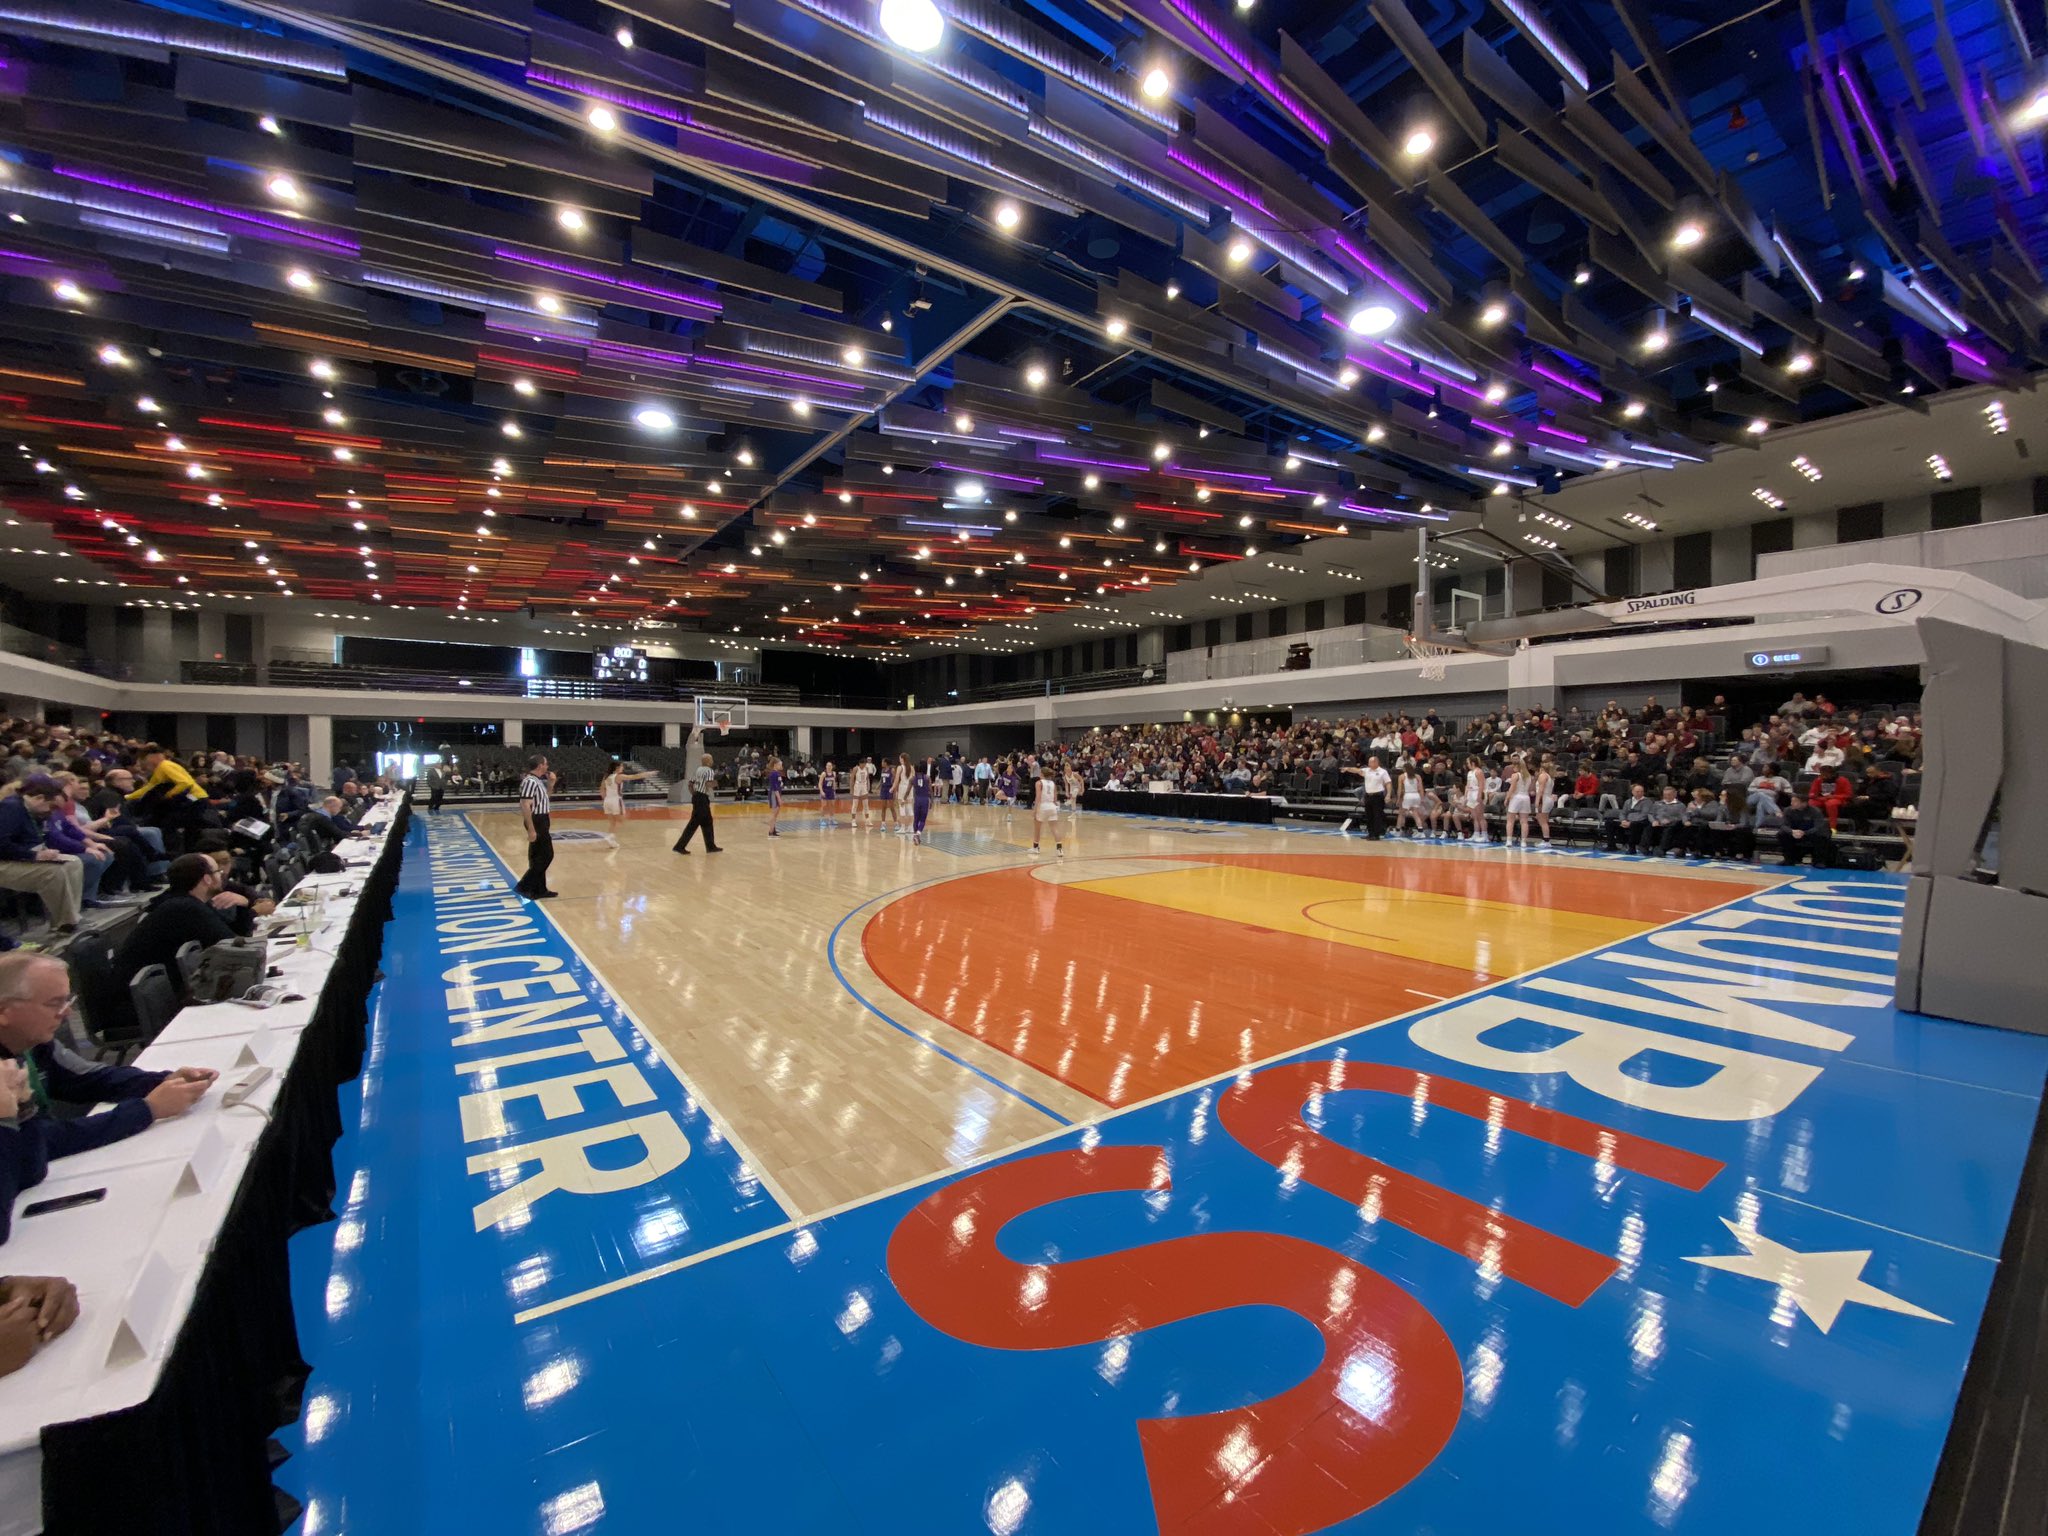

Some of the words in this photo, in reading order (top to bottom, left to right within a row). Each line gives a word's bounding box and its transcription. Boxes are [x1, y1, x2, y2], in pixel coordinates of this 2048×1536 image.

[1627, 591, 1696, 614] SPALDING
[430, 857, 547, 954] CONVENTION
[442, 955, 692, 1233] CENTER
